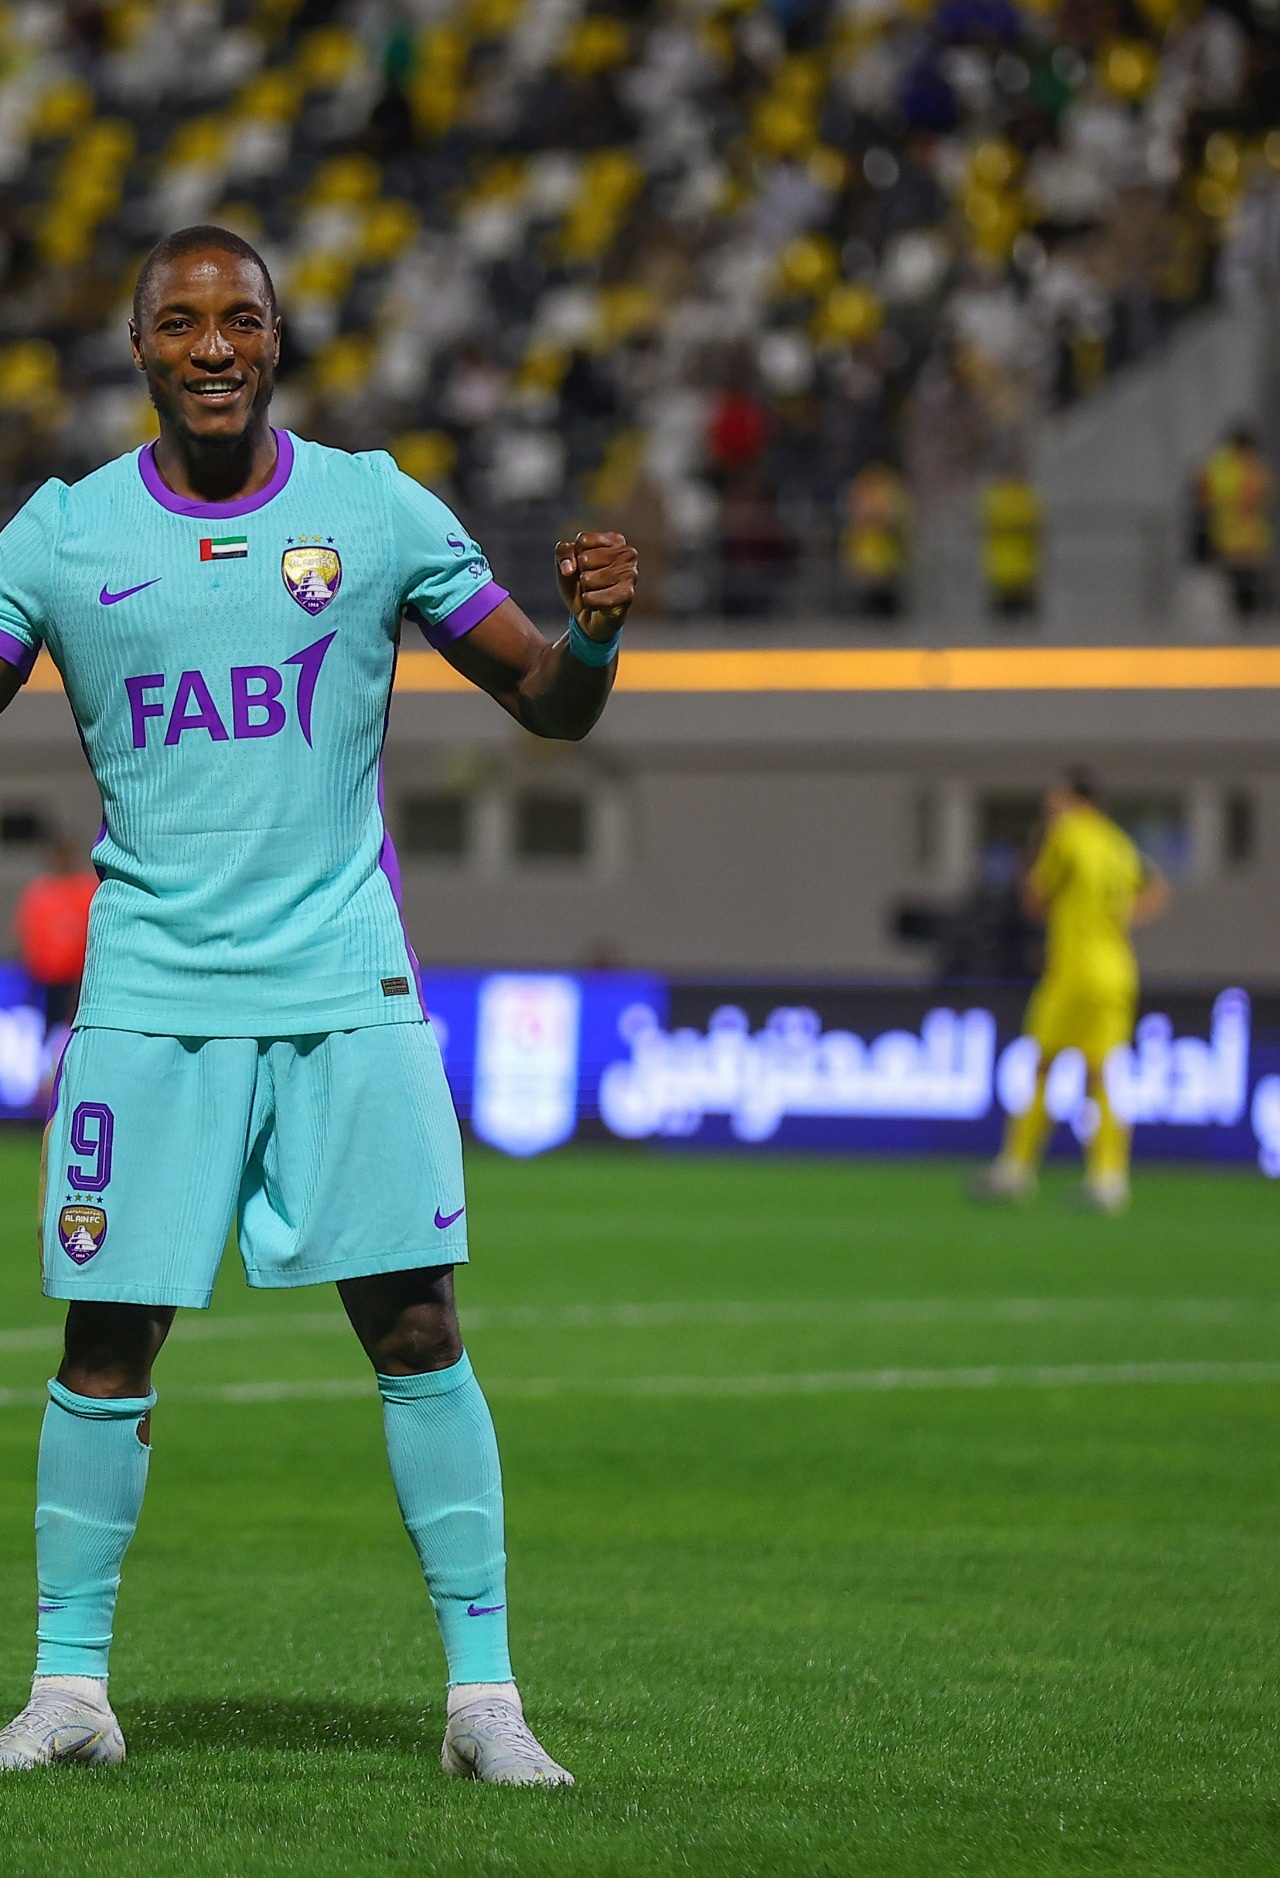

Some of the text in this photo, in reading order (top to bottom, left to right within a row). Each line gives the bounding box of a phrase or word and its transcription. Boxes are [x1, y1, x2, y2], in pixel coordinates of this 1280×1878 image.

[66, 1101, 115, 1193] 9
[65, 1214, 101, 1224] AL AIN FC
